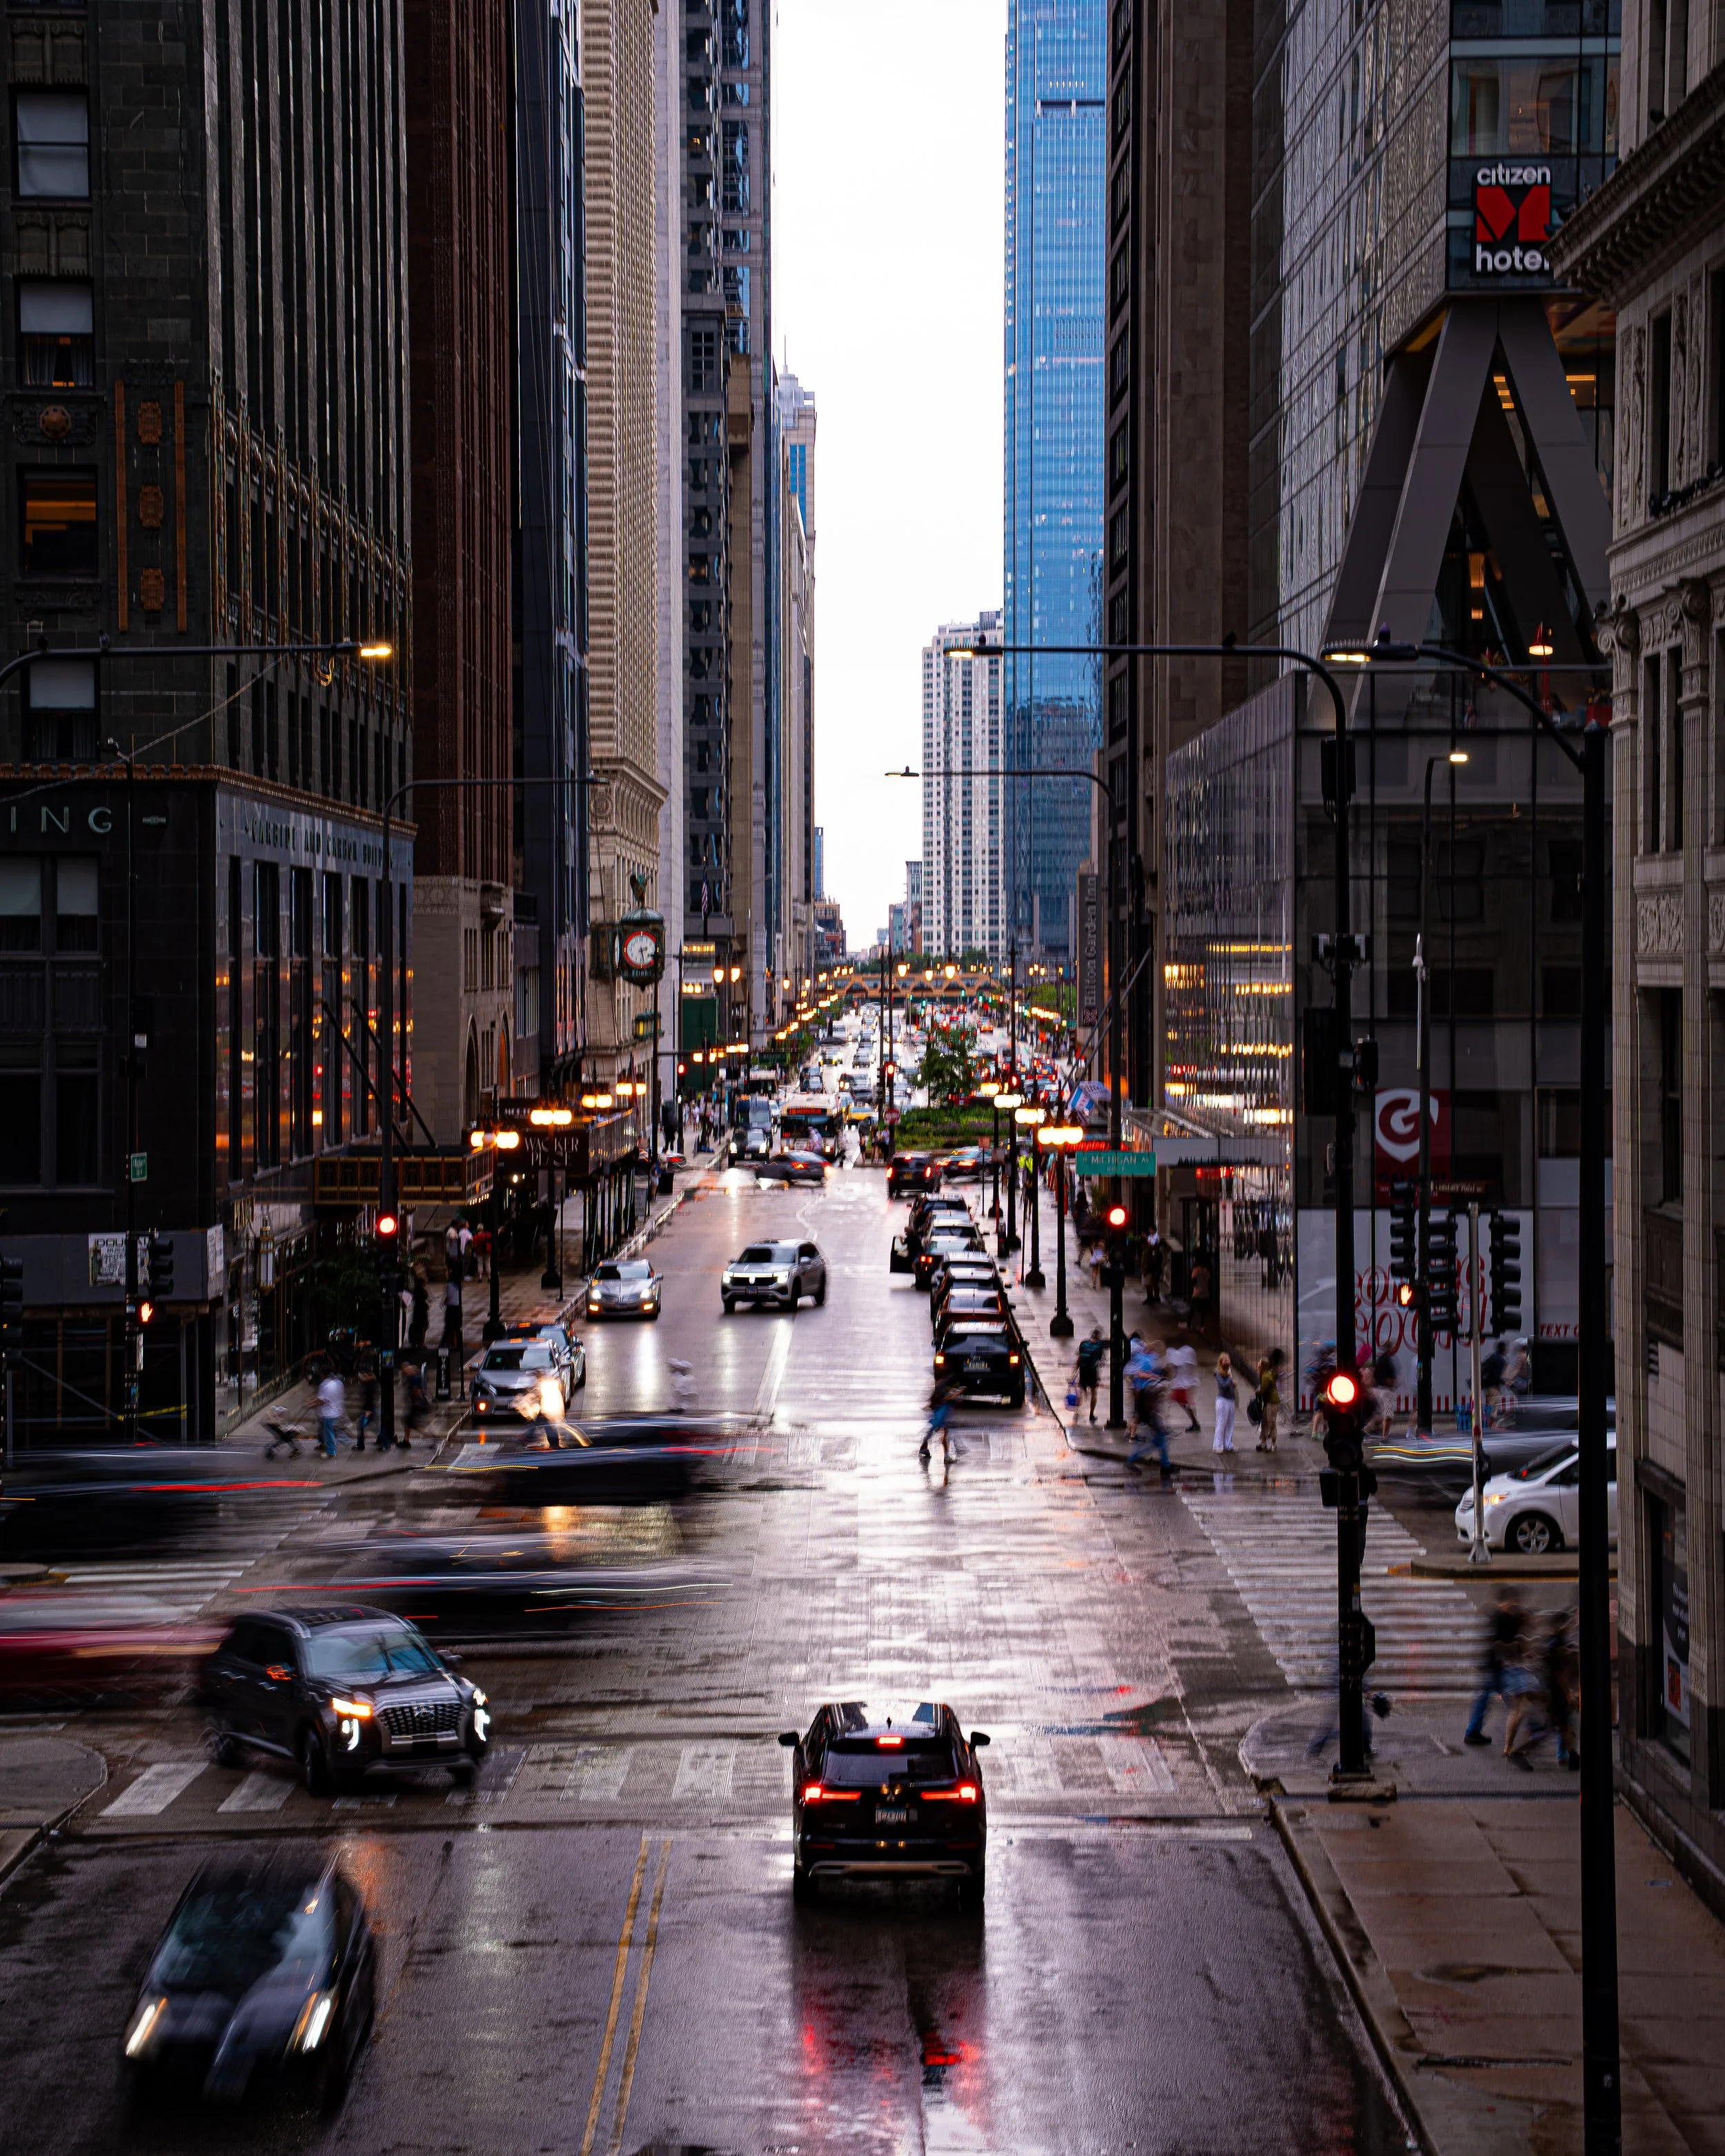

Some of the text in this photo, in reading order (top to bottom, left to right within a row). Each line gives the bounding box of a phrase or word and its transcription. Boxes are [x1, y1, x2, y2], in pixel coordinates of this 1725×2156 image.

[1477, 162, 1551, 186] citizen
[251, 819, 393, 869] CARBIDE AND CARBON BUILDG
[1085, 877, 1096, 1007] Hilton Garden Inn
[524, 1136, 578, 1152] WACKER
[531, 1150, 572, 1167] PLCE
[1091, 1155, 1136, 1165] MICHIGAN
[1539, 1323, 1570, 1337] TEXT
